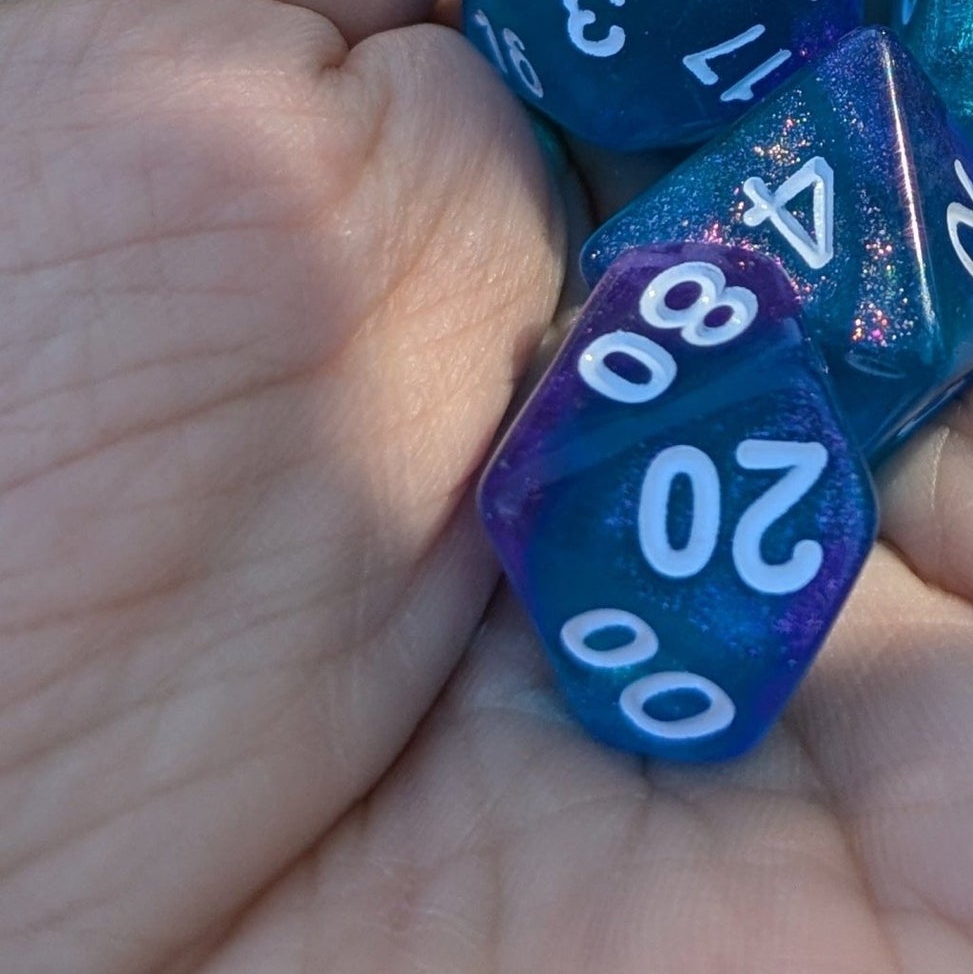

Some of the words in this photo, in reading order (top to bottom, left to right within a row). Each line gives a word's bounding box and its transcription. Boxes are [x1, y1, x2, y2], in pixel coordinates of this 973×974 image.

[682, 24, 793, 103] 17
[742, 155, 835, 270] 4
[576, 260, 760, 405] 80
[637, 438, 830, 596] 20
[559, 607, 737, 740] 00
